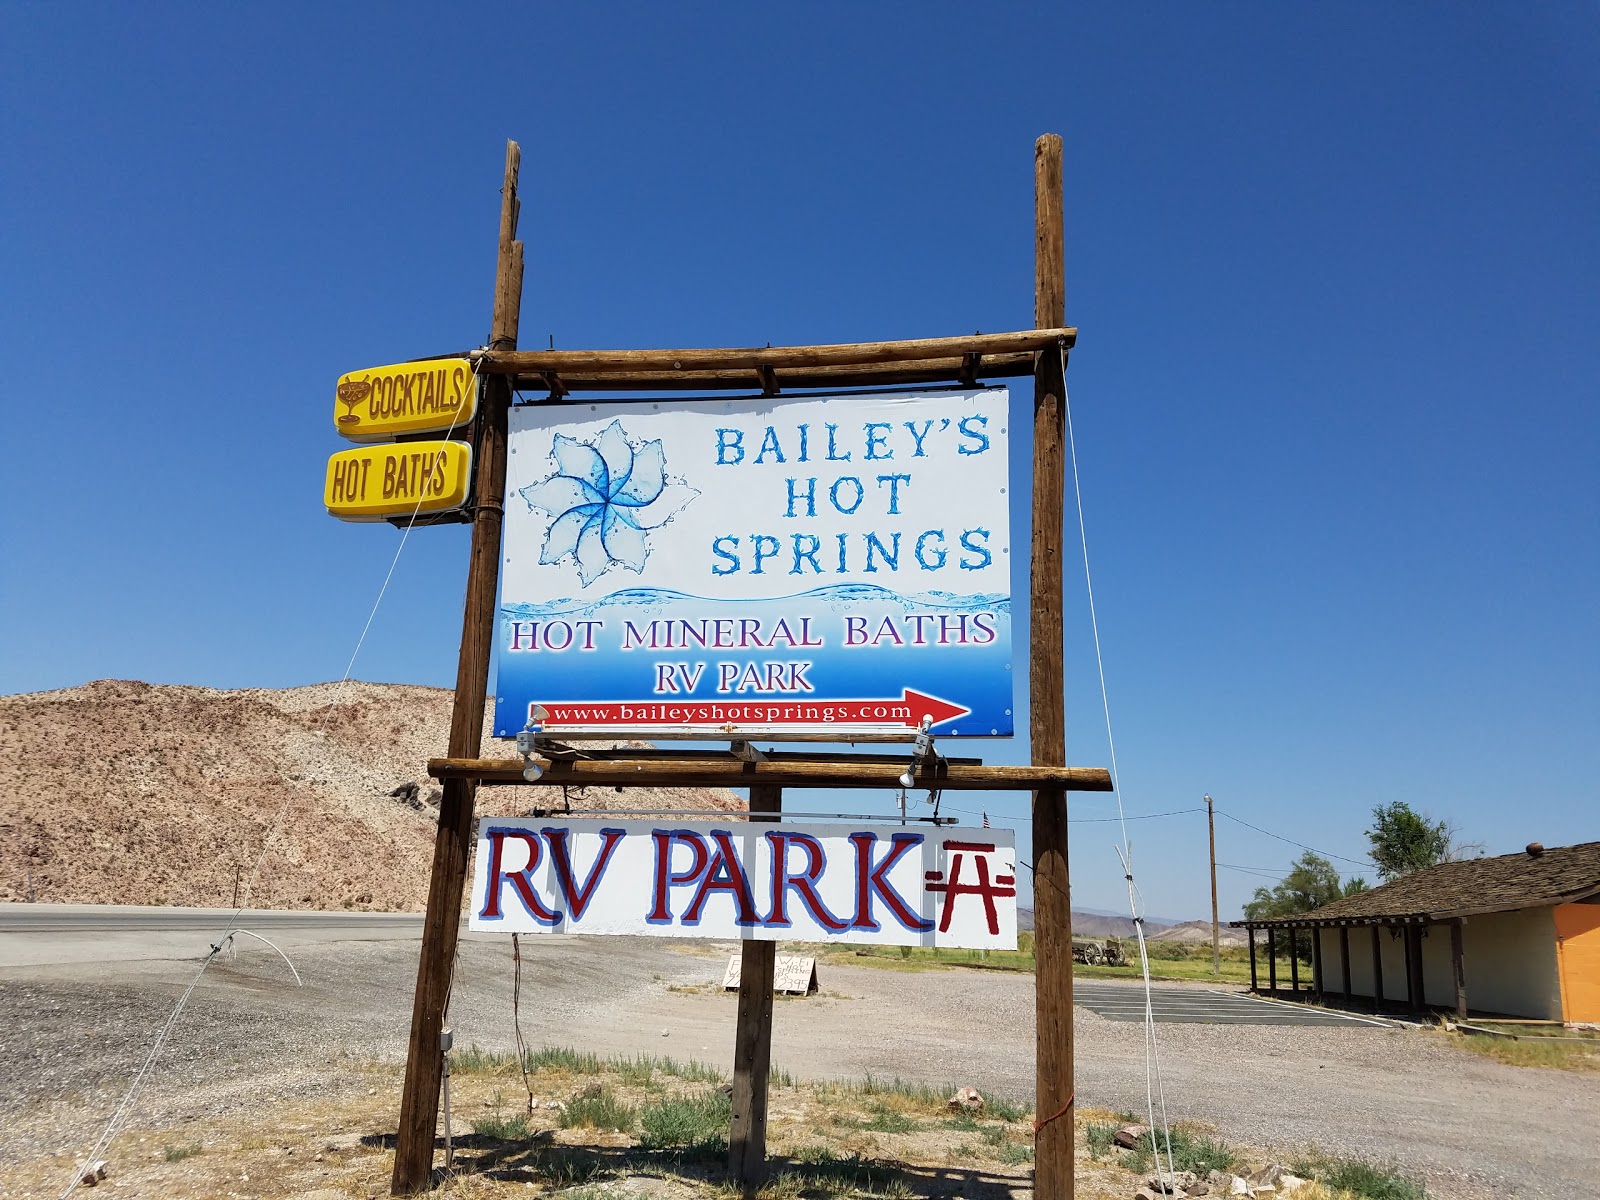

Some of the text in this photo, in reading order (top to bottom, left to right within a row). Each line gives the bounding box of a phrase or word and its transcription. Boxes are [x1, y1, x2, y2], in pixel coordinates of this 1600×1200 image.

[369, 367, 464, 419] COCKTAILS
[714, 413, 991, 466] BAILEY'S
[332, 450, 447, 503] HOT BATHS
[783, 472, 911, 518] HOT
[711, 526, 992, 576] SPRINGS
[510, 613, 995, 650] HOT MINERAL BATHS
[655, 663, 813, 692] RV PARK
[554, 704, 912, 723] www.baileyshotsprings.com
[478, 825, 937, 933] RV PARK
